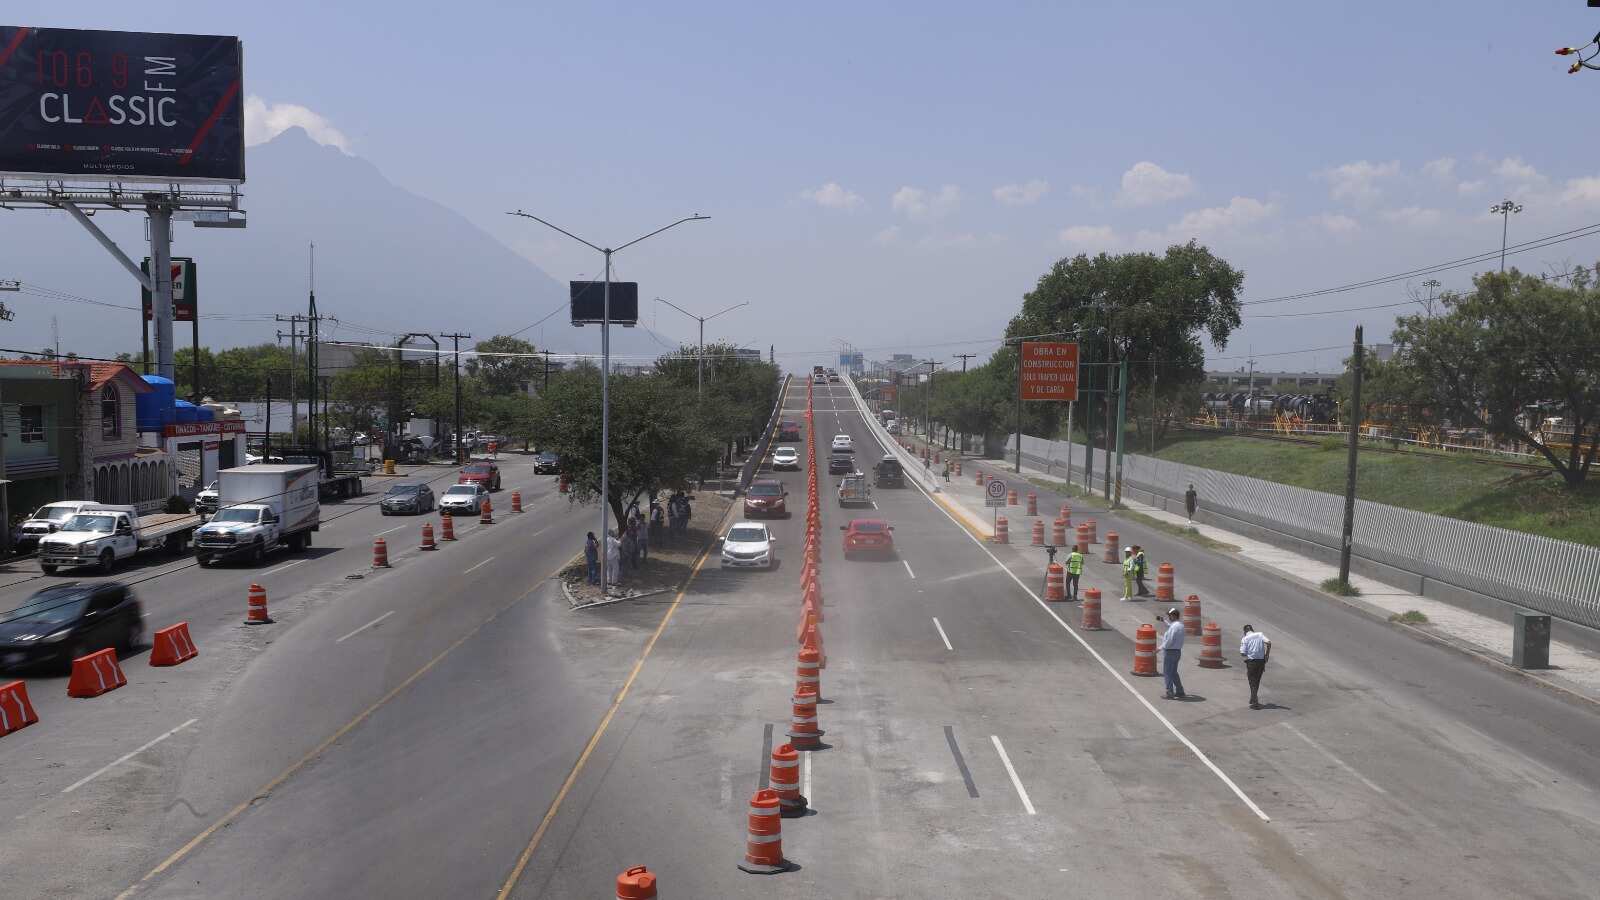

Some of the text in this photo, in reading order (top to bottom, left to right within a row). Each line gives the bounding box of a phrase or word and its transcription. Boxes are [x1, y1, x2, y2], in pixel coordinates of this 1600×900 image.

[144, 56, 177, 92] FM
[40, 92, 177, 127] CLASSIC
[1033, 347, 1067, 356] OBRA EN
[1036, 385, 1045, 393] DE
[991, 484, 1002, 493] 50
